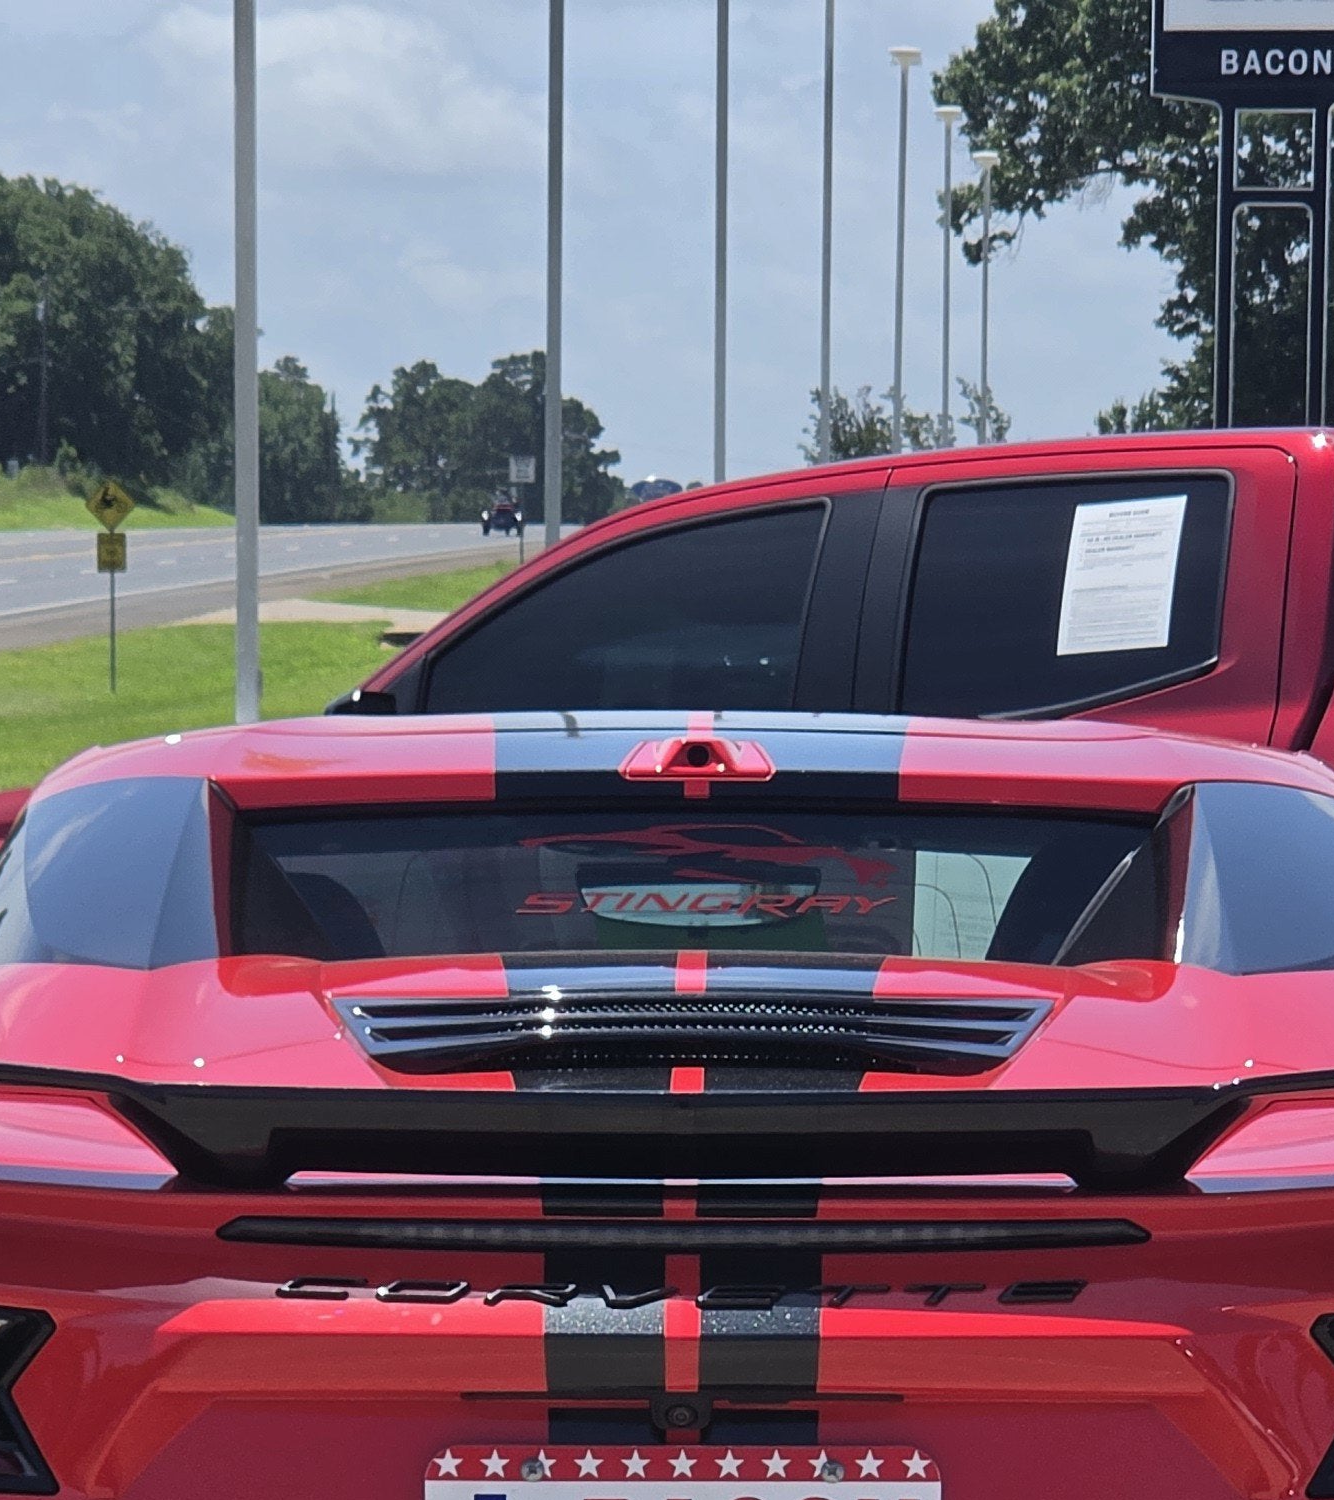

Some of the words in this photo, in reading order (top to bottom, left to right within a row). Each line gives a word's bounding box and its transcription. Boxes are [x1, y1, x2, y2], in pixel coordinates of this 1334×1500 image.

[1220, 48, 1333, 76] BACON
[516, 891, 898, 919] STINGRAY
[275, 1277, 1090, 1309] CORVETTE
